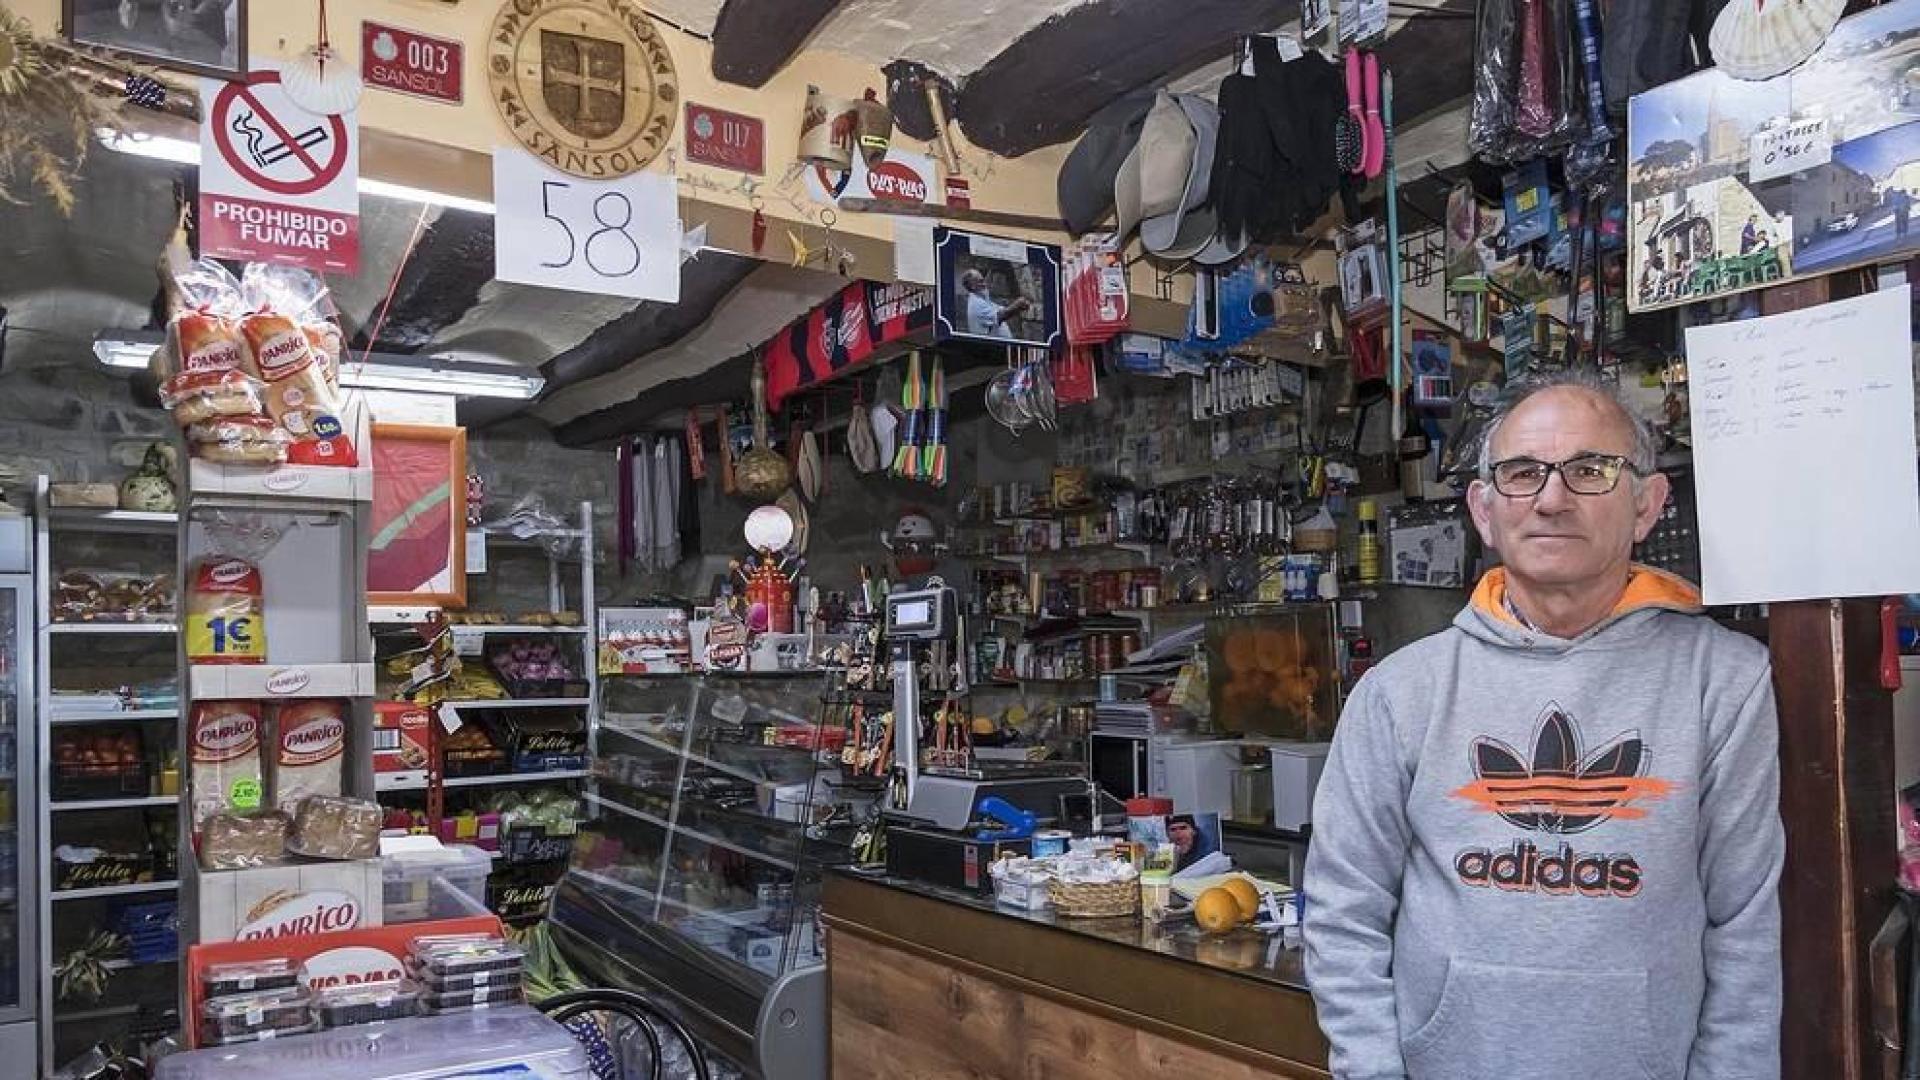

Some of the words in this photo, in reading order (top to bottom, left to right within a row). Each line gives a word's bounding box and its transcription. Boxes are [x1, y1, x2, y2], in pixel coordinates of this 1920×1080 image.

[408, 40, 448, 74] 003
[371, 65, 452, 95] SANSOL
[723, 121, 750, 147] 017
[526, 131, 647, 175] SANSOL
[213, 201, 347, 236] PROHIBIDO
[540, 181, 640, 277] 58
[241, 223, 329, 250] FUMAR
[207, 617, 252, 653] 1€
[1456, 838, 1643, 898] adidas
